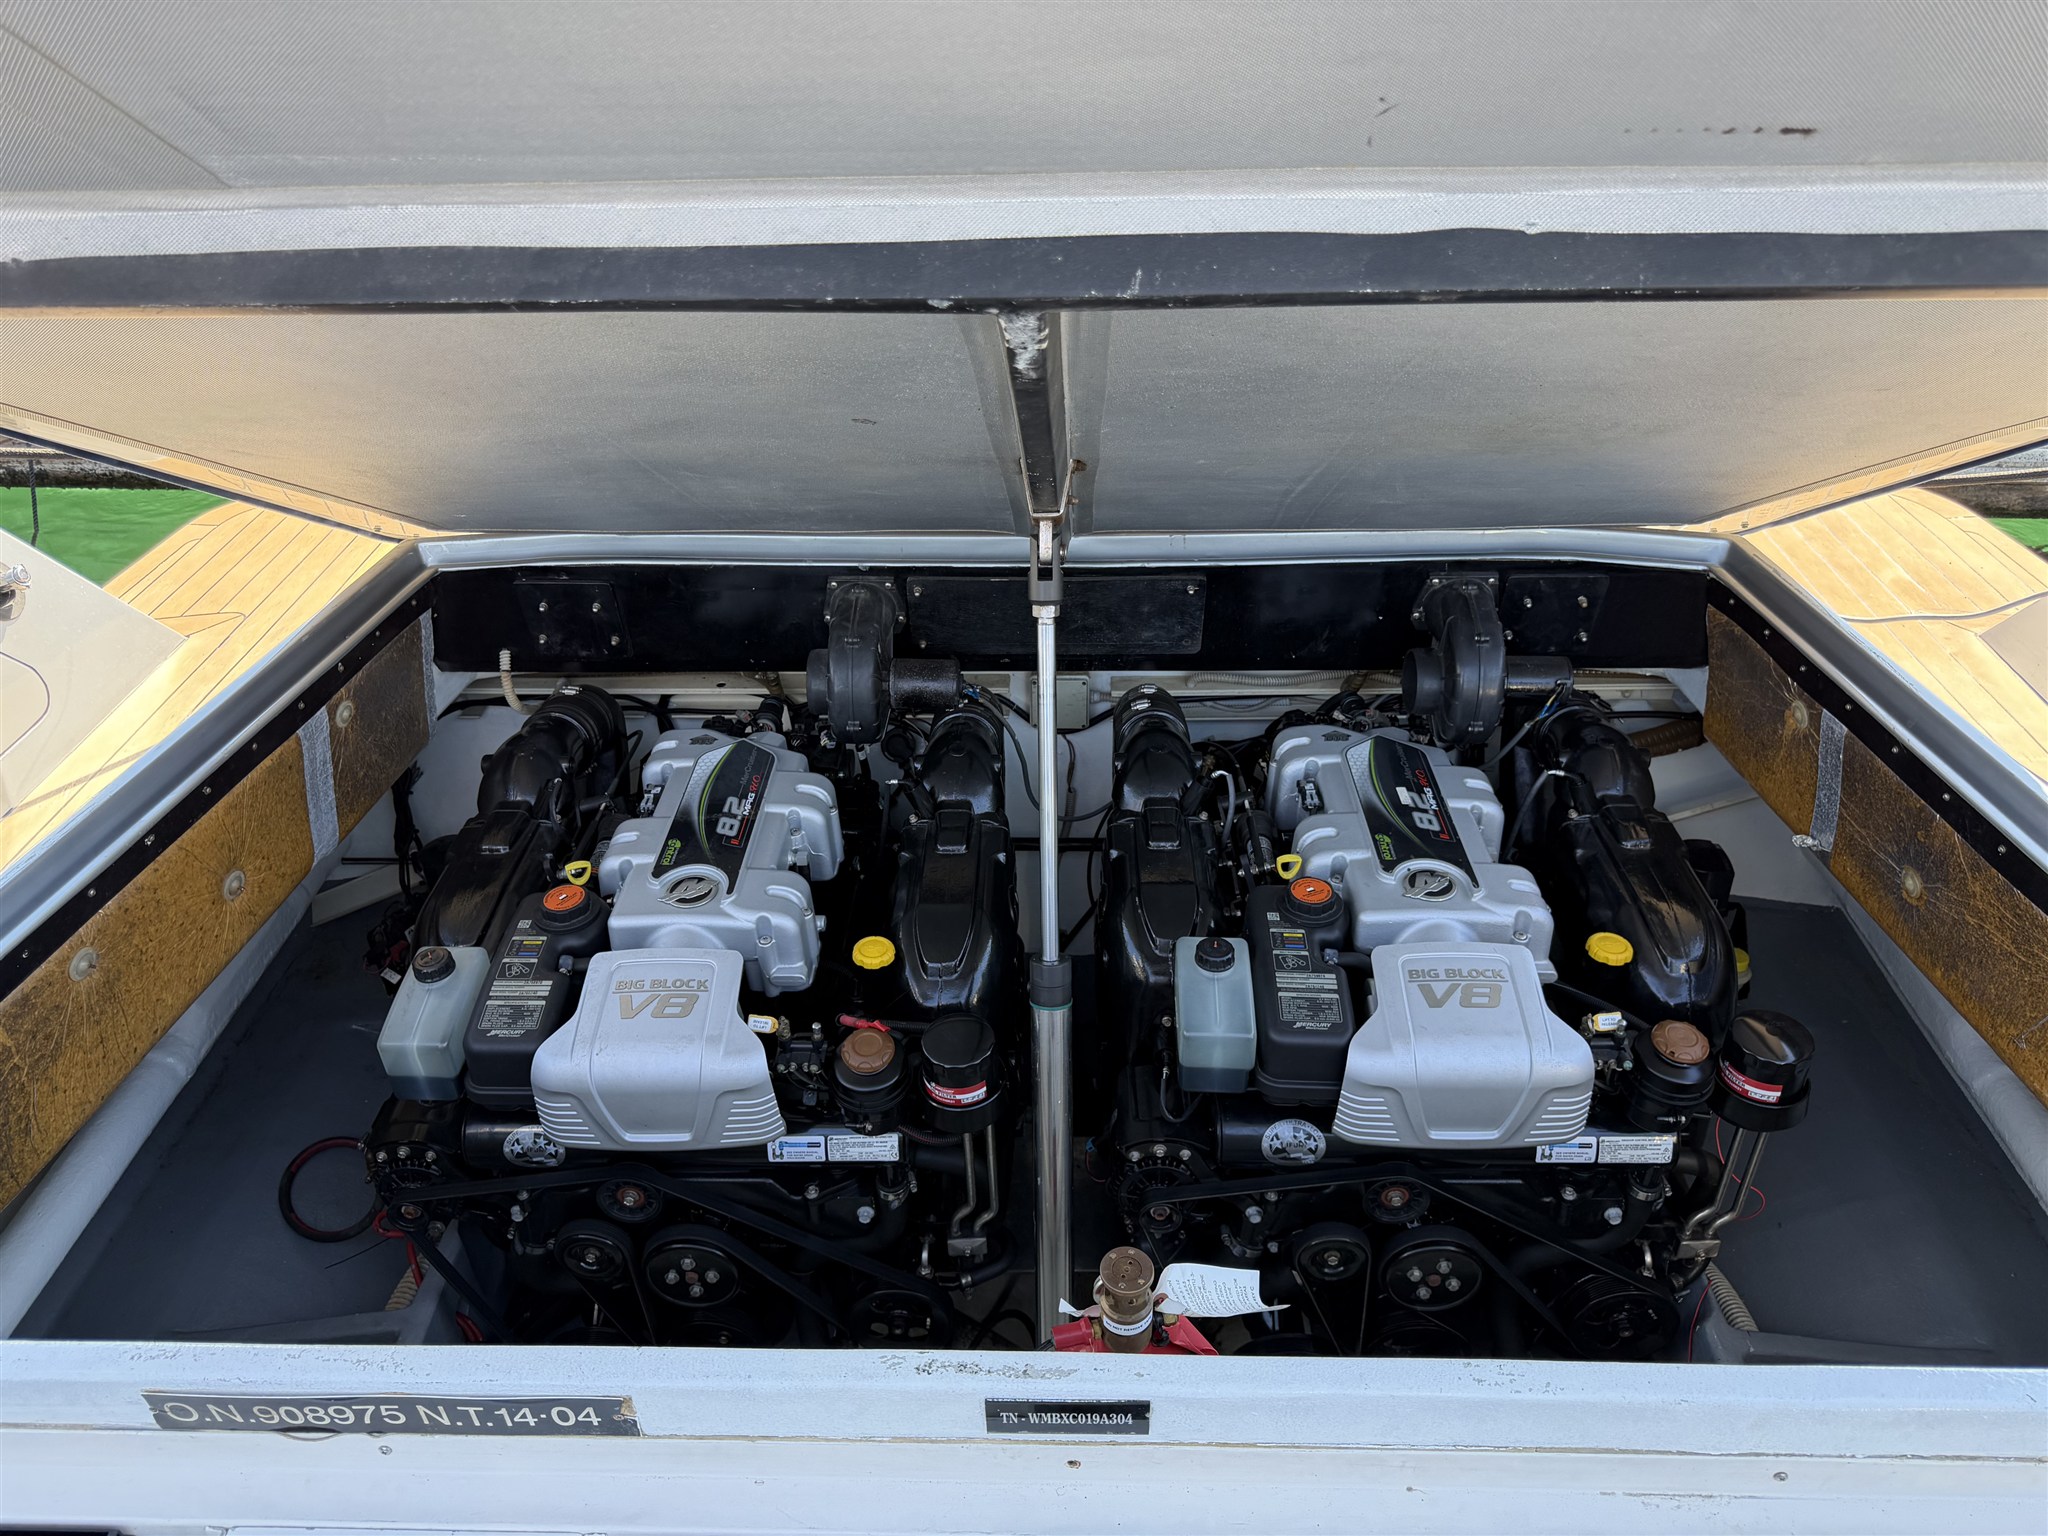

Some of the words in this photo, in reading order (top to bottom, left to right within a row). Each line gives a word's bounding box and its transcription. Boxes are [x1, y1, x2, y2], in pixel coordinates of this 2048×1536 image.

[1408, 968, 1440, 979] BIG
[1444, 968, 1506, 979] BLOCK
[615, 978, 645, 991] BIG
[650, 978, 709, 991] BLOCK
[1417, 982, 1503, 1009] V8
[619, 993, 700, 1020] V8
[1294, 1021, 1332, 1029] MERCURY
[487, 1029, 526, 1037] MERCURY
[163, 1402, 406, 1426] O.N.908975
[1000, 1412, 1019, 1424] TN
[1027, 1413, 1133, 1425] WMBXC019A304
